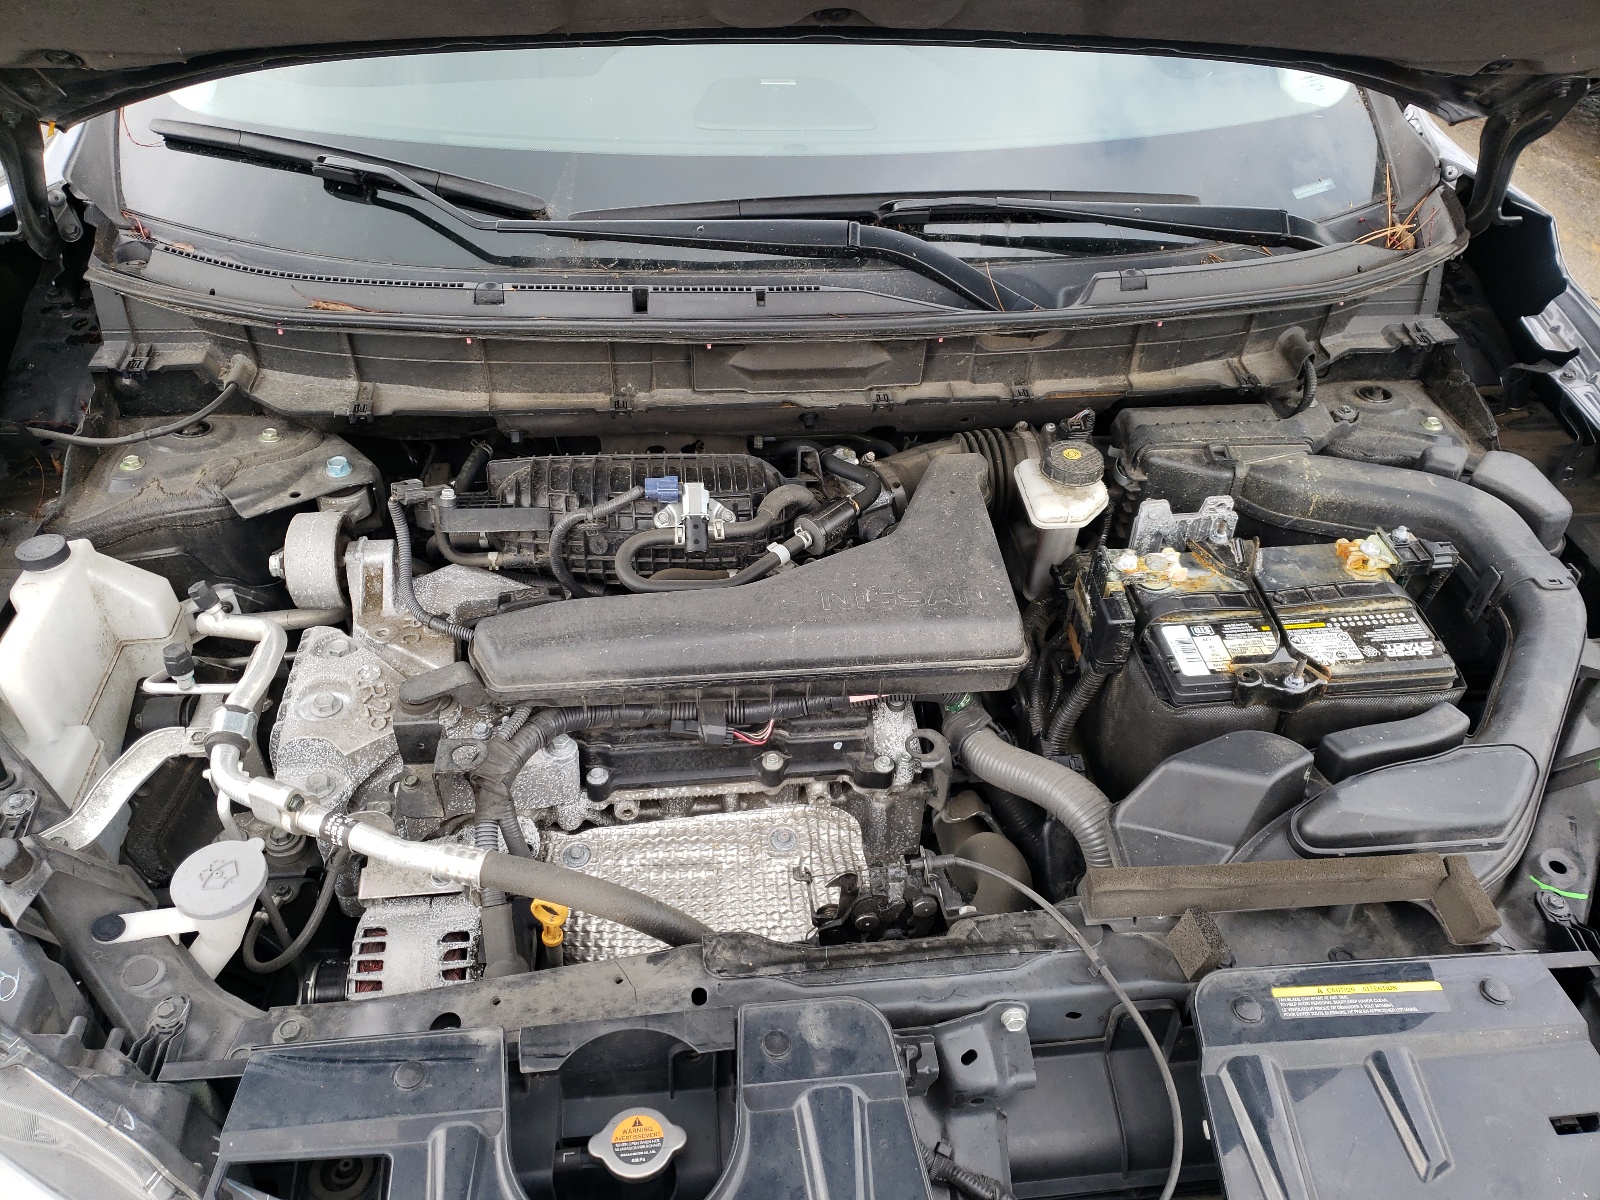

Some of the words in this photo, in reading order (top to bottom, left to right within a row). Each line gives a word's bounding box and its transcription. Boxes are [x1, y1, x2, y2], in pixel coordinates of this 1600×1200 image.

[817, 585, 990, 611] NISSAN
[1383, 641, 1434, 651] START
[622, 1126, 653, 1135] WARNING
[614, 1132, 661, 1142] AVERTISSEMENT
